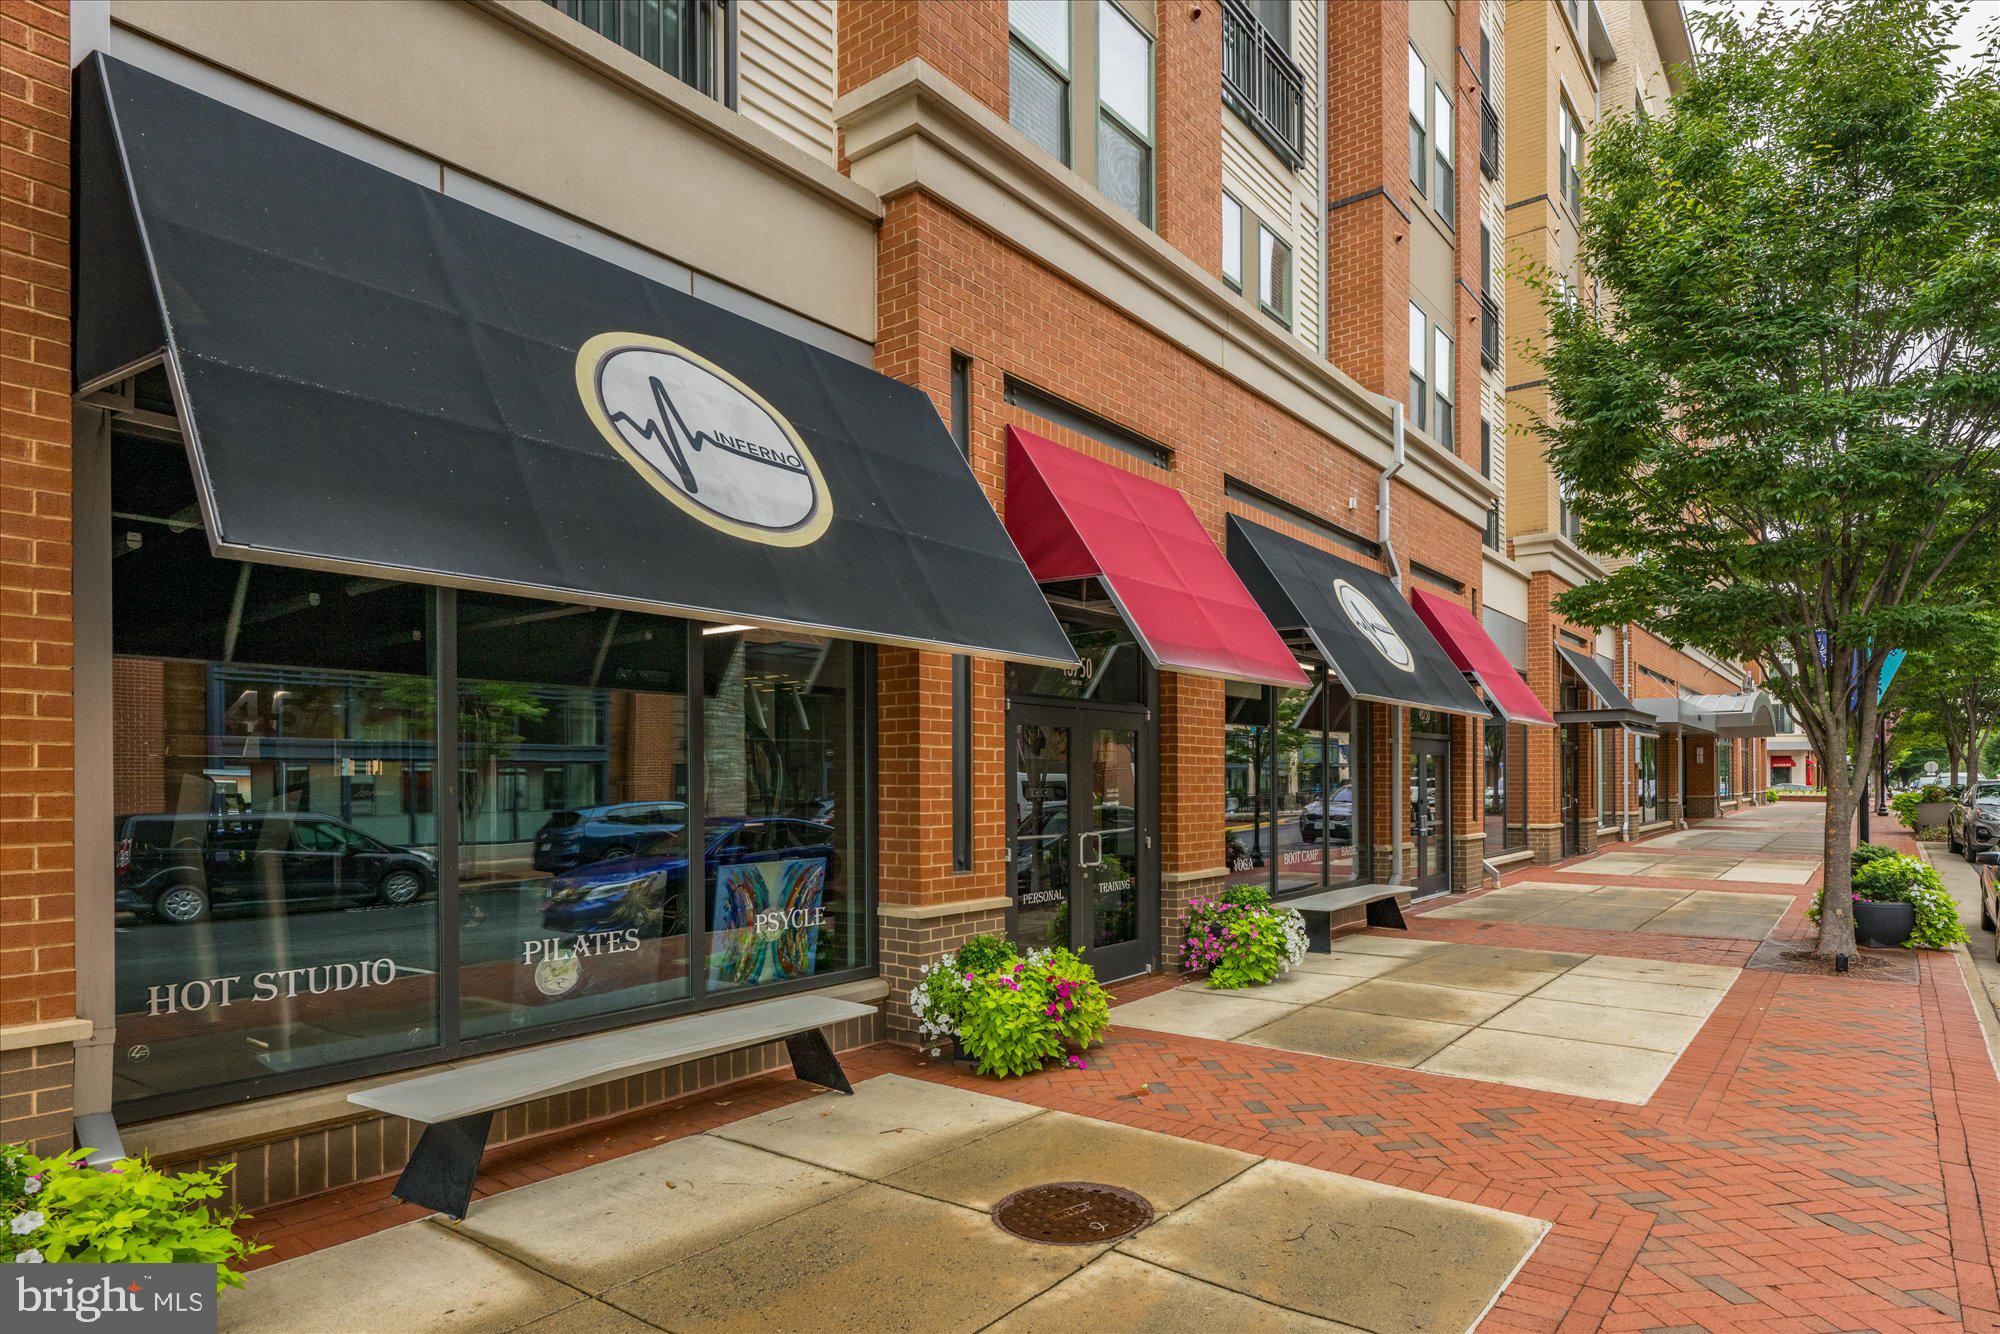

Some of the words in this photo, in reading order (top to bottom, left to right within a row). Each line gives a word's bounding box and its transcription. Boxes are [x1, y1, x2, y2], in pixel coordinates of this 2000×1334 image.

[713, 430, 801, 467] INFERNO
[1233, 858, 1254, 871] YOGA
[1284, 852, 1301, 865] BOOT
[1302, 850, 1319, 862] CAMP
[1023, 889, 1065, 904] PERSONAL
[1099, 880, 1130, 893] TRAINING
[755, 906, 826, 933] PSYCLE
[523, 928, 641, 965] PILATES
[147, 975, 241, 1016] HOT
[252, 958, 396, 1002] STUDIO
